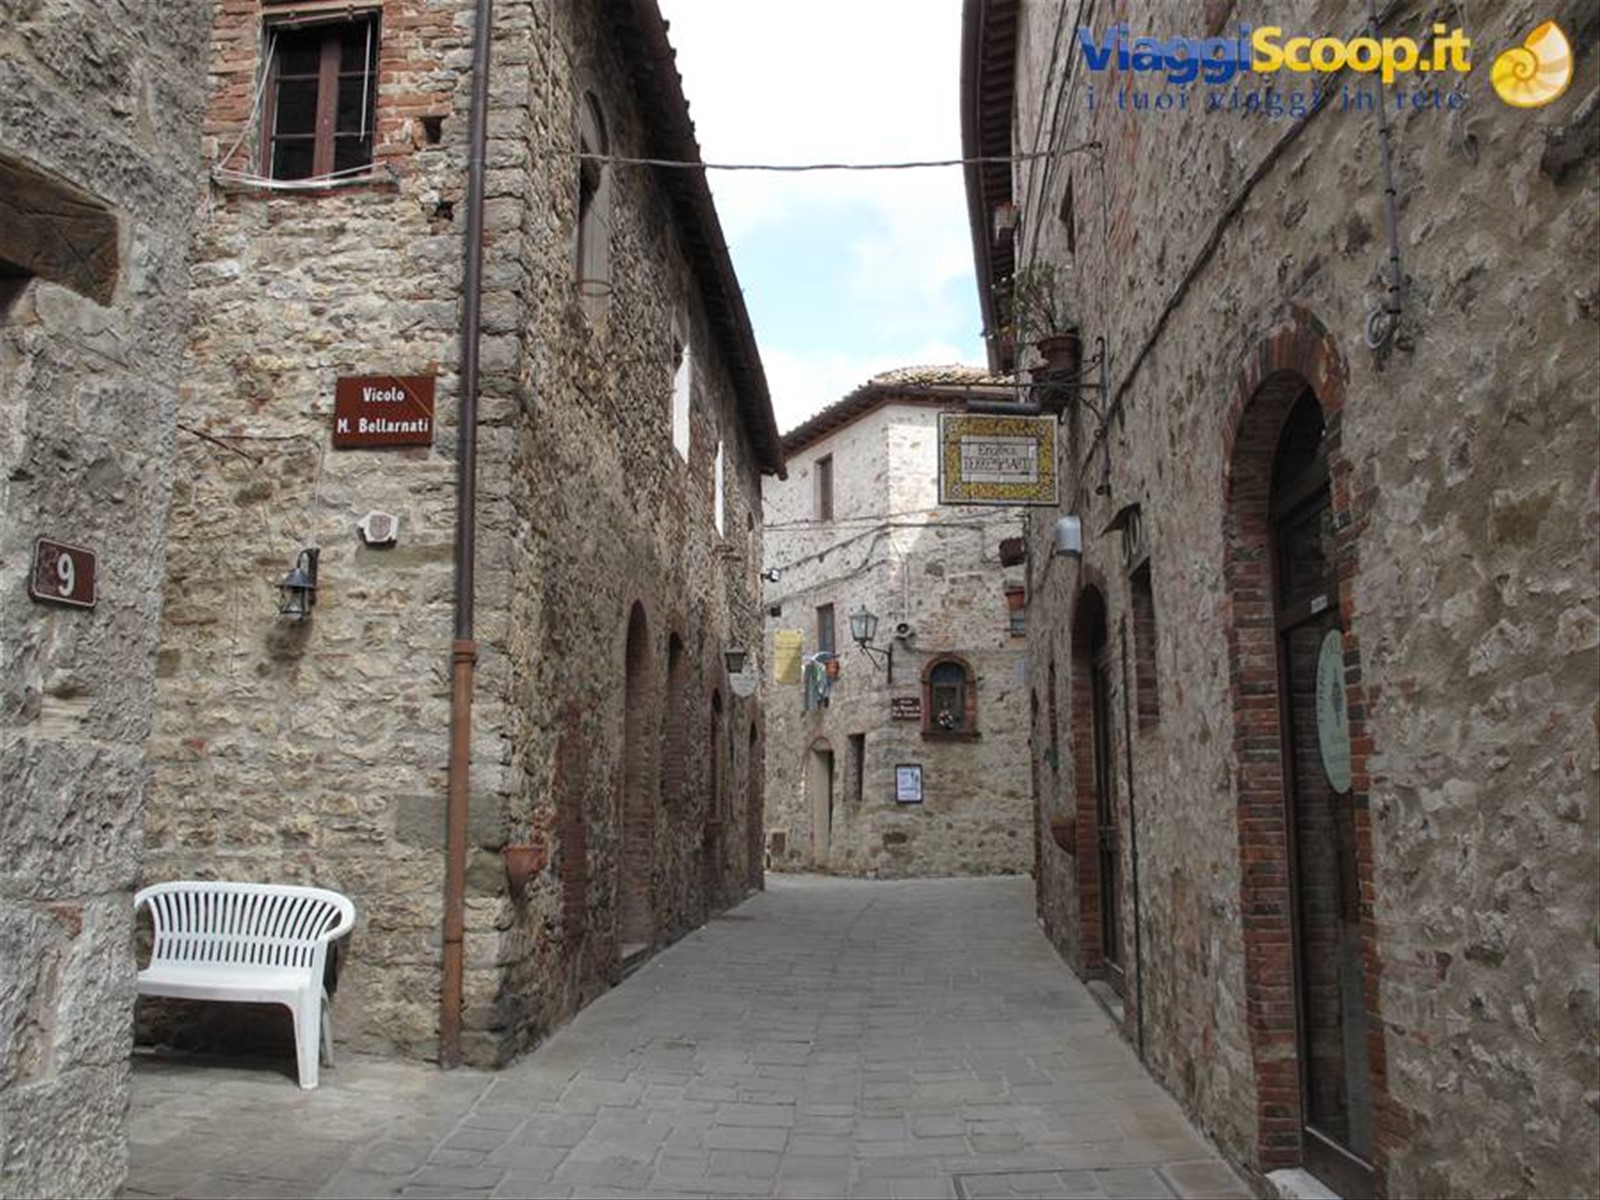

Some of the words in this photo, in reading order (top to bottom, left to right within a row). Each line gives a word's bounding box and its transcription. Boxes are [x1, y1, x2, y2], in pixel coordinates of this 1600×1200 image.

[362, 386, 405, 402] Vicolo
[337, 418, 351, 434] M.
[359, 416, 429, 434] Bellarnati
[57, 552, 75, 597] 9
